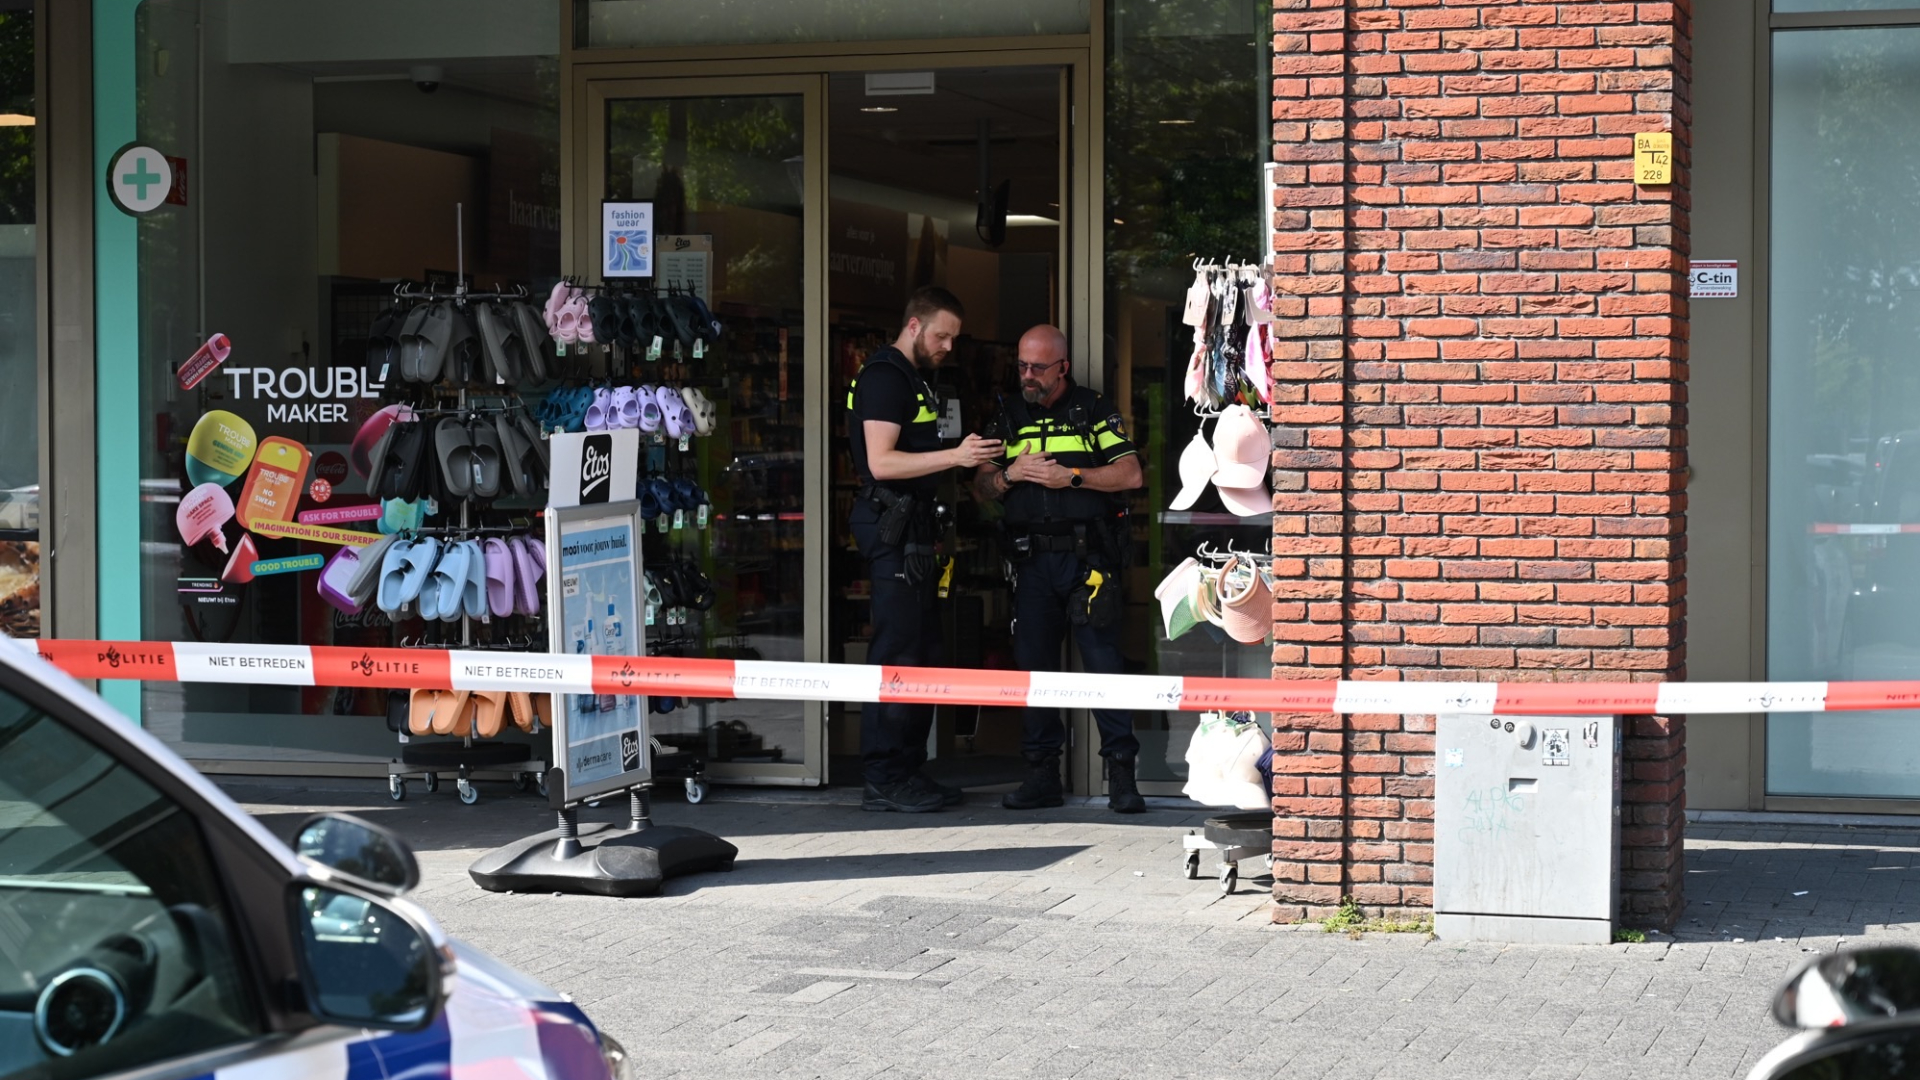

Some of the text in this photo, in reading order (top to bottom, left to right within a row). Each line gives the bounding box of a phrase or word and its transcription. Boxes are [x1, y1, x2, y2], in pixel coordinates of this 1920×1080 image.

[1638, 139, 1650, 149] BA
[1656, 155, 1668, 165] 42
[1643, 170, 1662, 180] 228
[611, 210, 645, 219] fashion
[617, 219, 639, 227] wear
[675, 237, 690, 248] Etos
[1697, 272, 1732, 283] C-tin
[267, 403, 349, 423] MAKER
[582, 445, 609, 482] Etos
[262, 488, 274, 497] NO
[254, 495, 277, 507] SWEAT
[303, 508, 379, 522] ASK FOR TROUBLE
[254, 522, 311, 537] IMAGINATION
[312, 529, 320, 537] IS
[321, 531, 341, 540] OUR
[563, 541, 580, 557] mooi
[580, 542, 594, 554] voor
[255, 557, 319, 573] GOOD TROUBLE
[98, 649, 165, 667] POLITIE
[209, 656, 305, 669] NIET BETREDEN
[351, 656, 420, 675] POLITIE
[464, 665, 564, 680] NIET BETREDEN
[728, 675, 830, 690] NIET BETREDEN
[999, 686, 1028, 697] NIET
[1281, 696, 1312, 704] NIET
[623, 737, 639, 758] Etos
